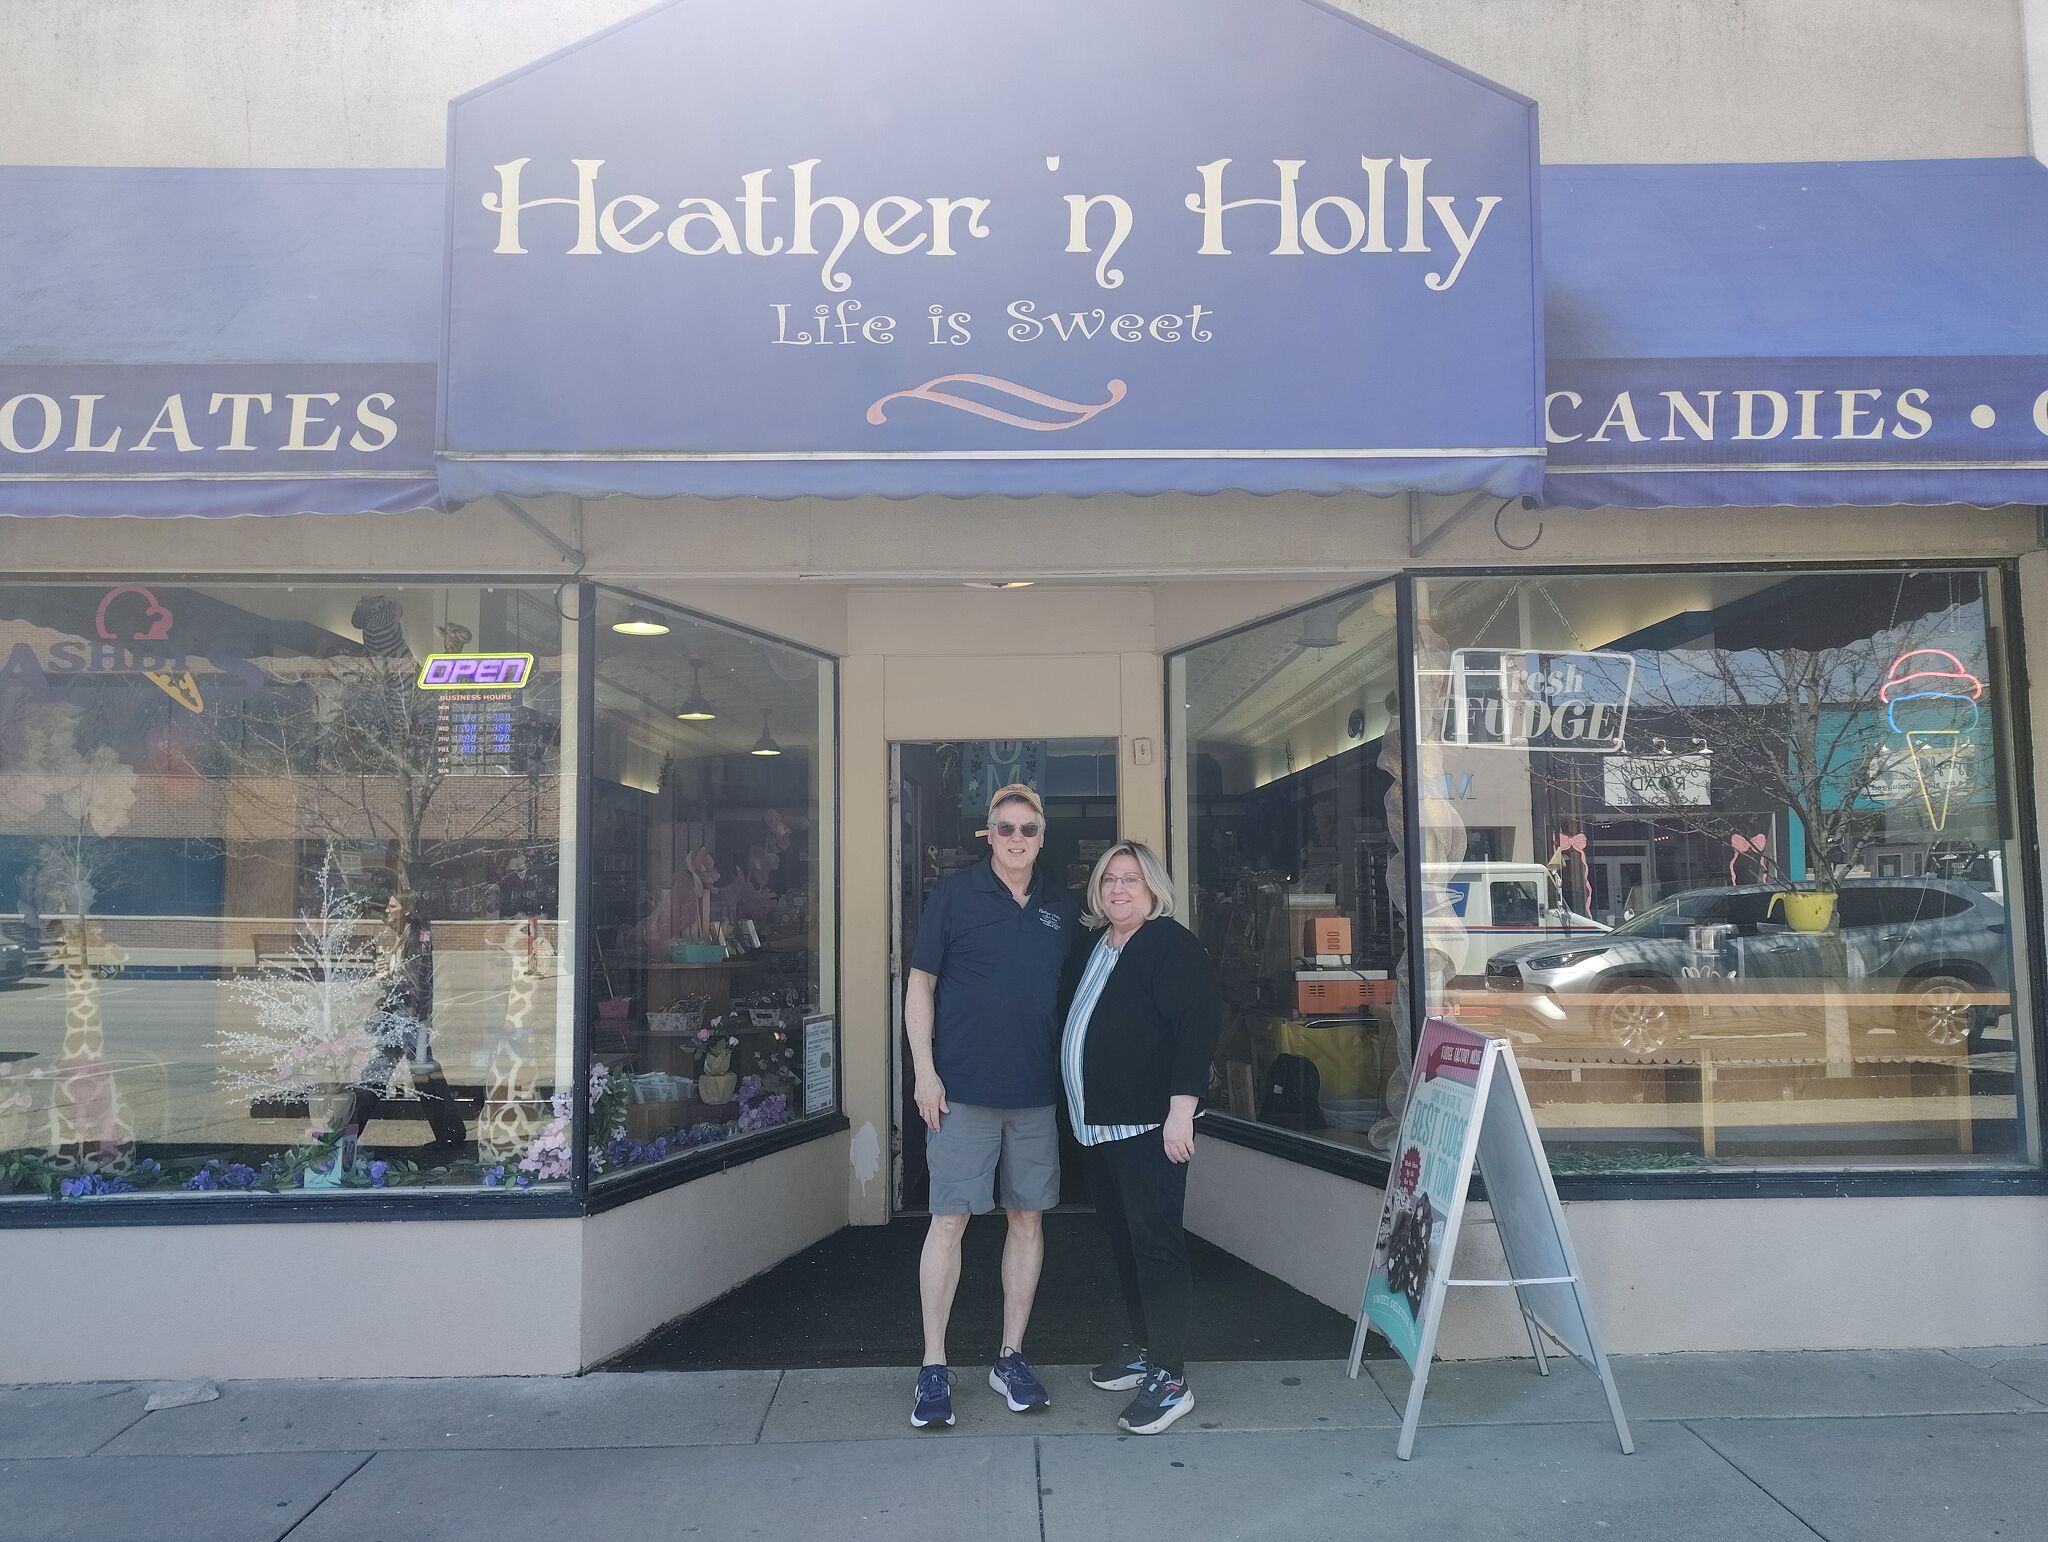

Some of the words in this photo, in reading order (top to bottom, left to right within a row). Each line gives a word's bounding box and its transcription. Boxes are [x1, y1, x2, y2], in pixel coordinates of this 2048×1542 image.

[481, 157, 991, 293] Heather
[1184, 153, 1504, 292] Holly
[769, 299, 897, 346] Life
[927, 304, 972, 346] is
[1006, 299, 1215, 344] Sweet
[0, 392, 399, 454] OLATES
[1545, 387, 1934, 444] CANDIES
[425, 659, 526, 683] OPEN
[439, 694, 482, 702] BUSINESS
[483, 693, 512, 701] HOURS
[1410, 1099, 1440, 1148] BEST
[1421, 1150, 1436, 1190] IN
